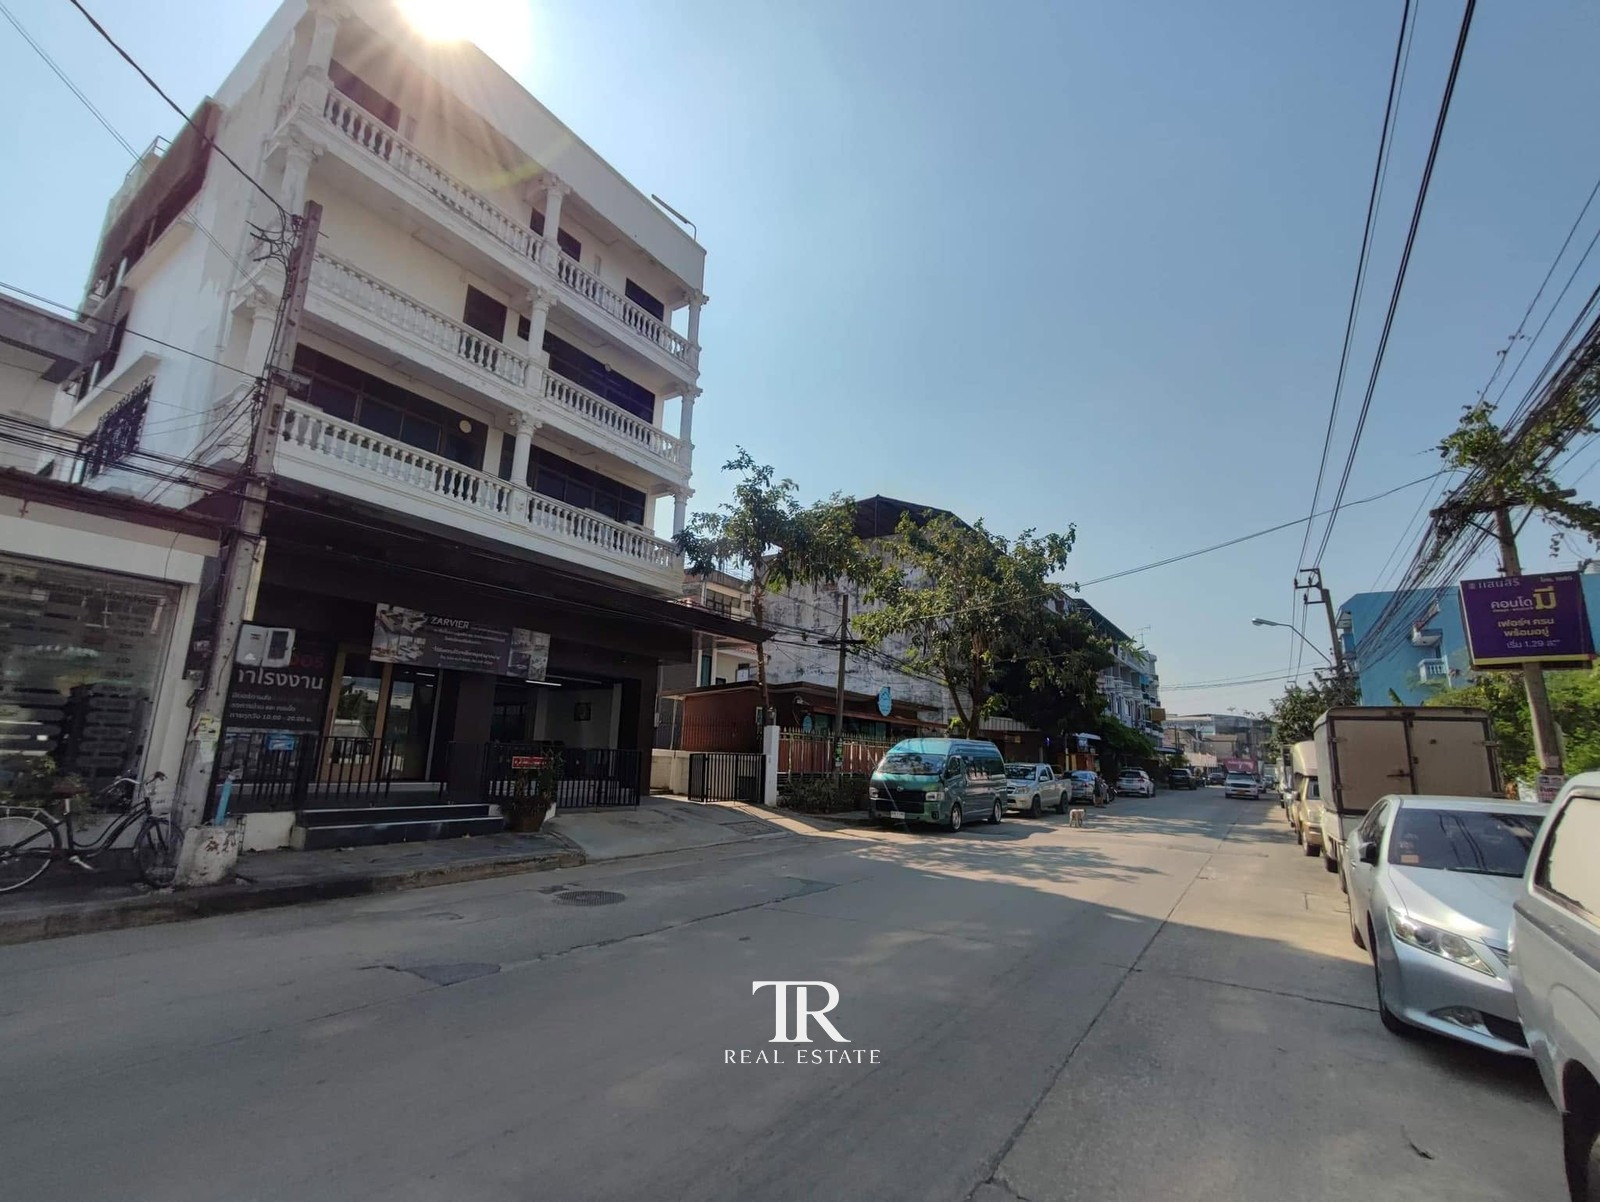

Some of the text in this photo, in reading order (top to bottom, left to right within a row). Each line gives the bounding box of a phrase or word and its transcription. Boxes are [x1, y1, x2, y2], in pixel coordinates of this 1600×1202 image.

[1491, 596, 1533, 609] คอนโด
[430, 616, 470, 629] ZARVIER
[1525, 640, 1544, 649] 1.29
